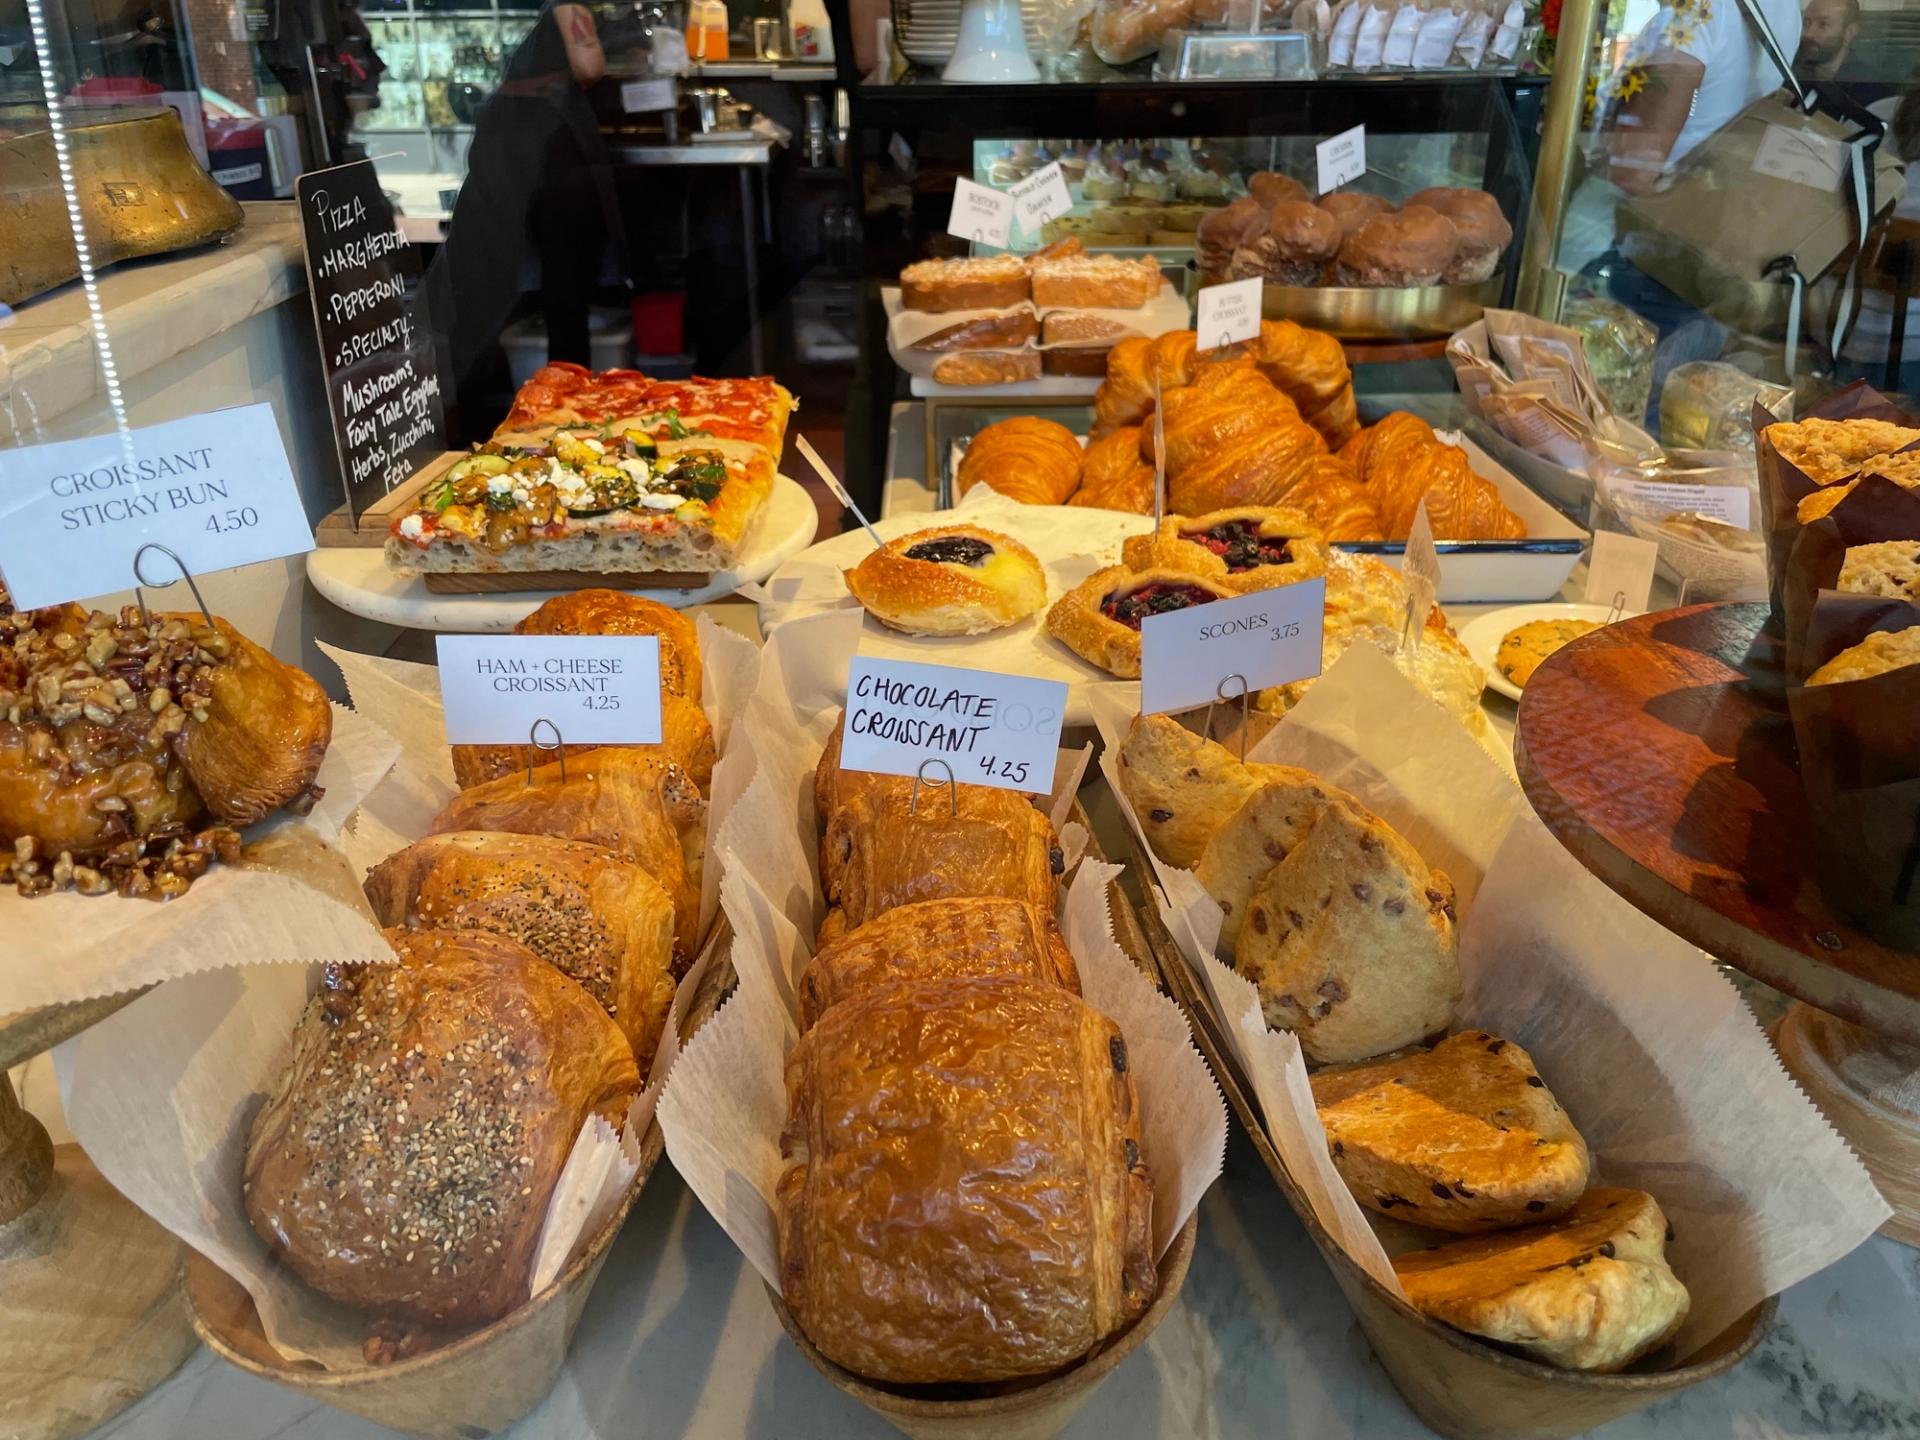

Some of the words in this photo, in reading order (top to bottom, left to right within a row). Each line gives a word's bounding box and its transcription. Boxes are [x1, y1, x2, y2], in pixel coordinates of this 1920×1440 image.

[323, 227, 410, 277] MARGHERITA
[330, 273, 406, 324] PEPPERONI
[342, 360, 418, 417] Mushrooms,
[346, 417, 377, 449] Fairy
[376, 400, 403, 427] Tale
[50, 447, 213, 497] CROISSANT
[351, 446, 391, 483] Herbs,
[383, 458, 413, 495] Feta
[60, 492, 161, 531] STICKY
[167, 479, 229, 510] BUN
[205, 506, 259, 534] 4.50
[1199, 613, 1268, 641] SCONES
[1271, 621, 1300, 642] 3.75
[477, 659, 527, 674] HAM
[544, 658, 624, 674] CHEESE
[493, 677, 609, 692] CROISSANT
[582, 695, 621, 710] 4.25
[856, 675, 998, 718] CHOCOLATE
[851, 708, 991, 753] CROISSANT
[979, 755, 1031, 783] 4.25
